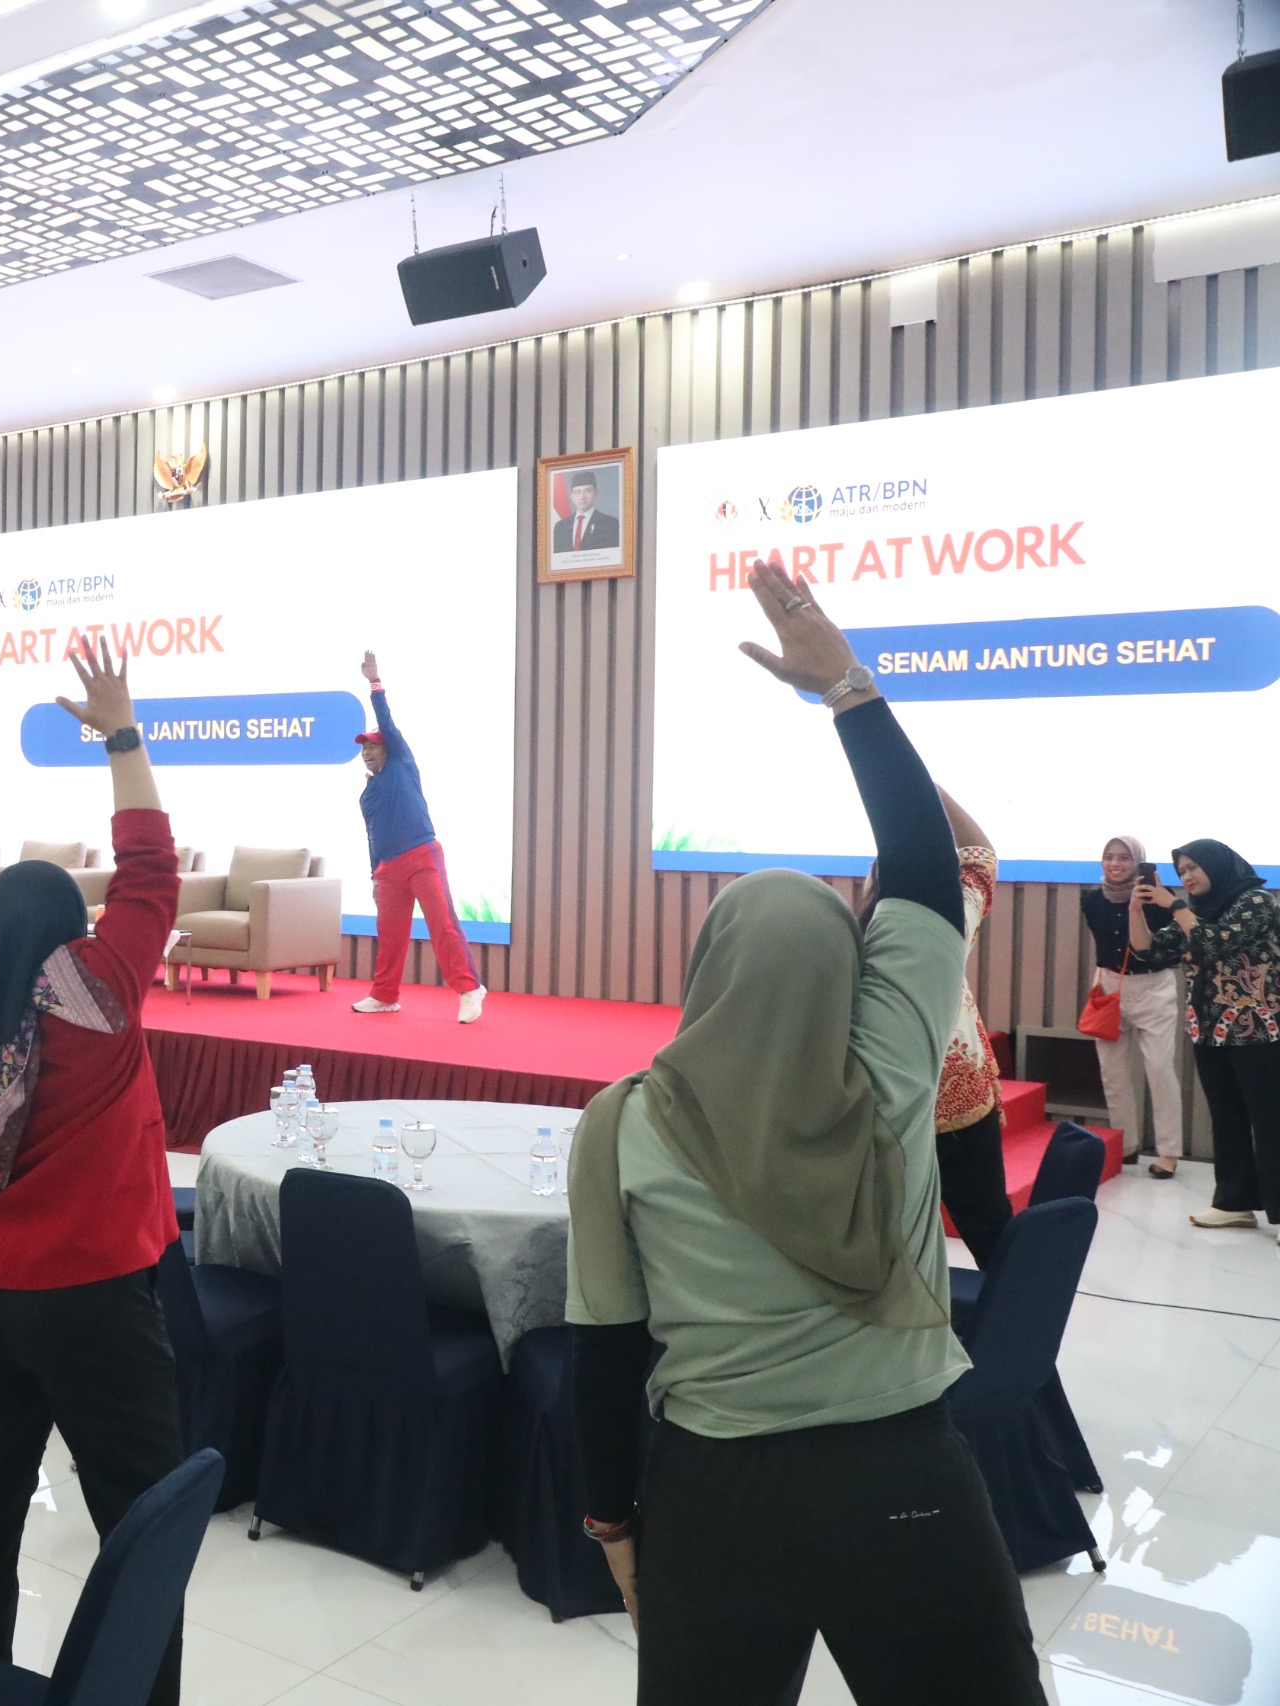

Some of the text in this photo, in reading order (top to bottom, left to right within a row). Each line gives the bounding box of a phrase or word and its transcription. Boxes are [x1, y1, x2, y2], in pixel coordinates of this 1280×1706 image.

[831, 478, 927, 505] ATR/BPN
[829, 500, 926, 518] maju dan modern
[709, 521, 1086, 592] HEART AT WORK
[47, 574, 114, 596] ATR/BPN
[46, 593, 114, 607] maju dan modern
[62, 624, 104, 662] AT
[110, 614, 225, 659] WORK
[876, 637, 1216, 675] SENAM JANTUNG SEHAT
[148, 719, 241, 742] JANTUNG
[246, 717, 315, 740] SEHAT
